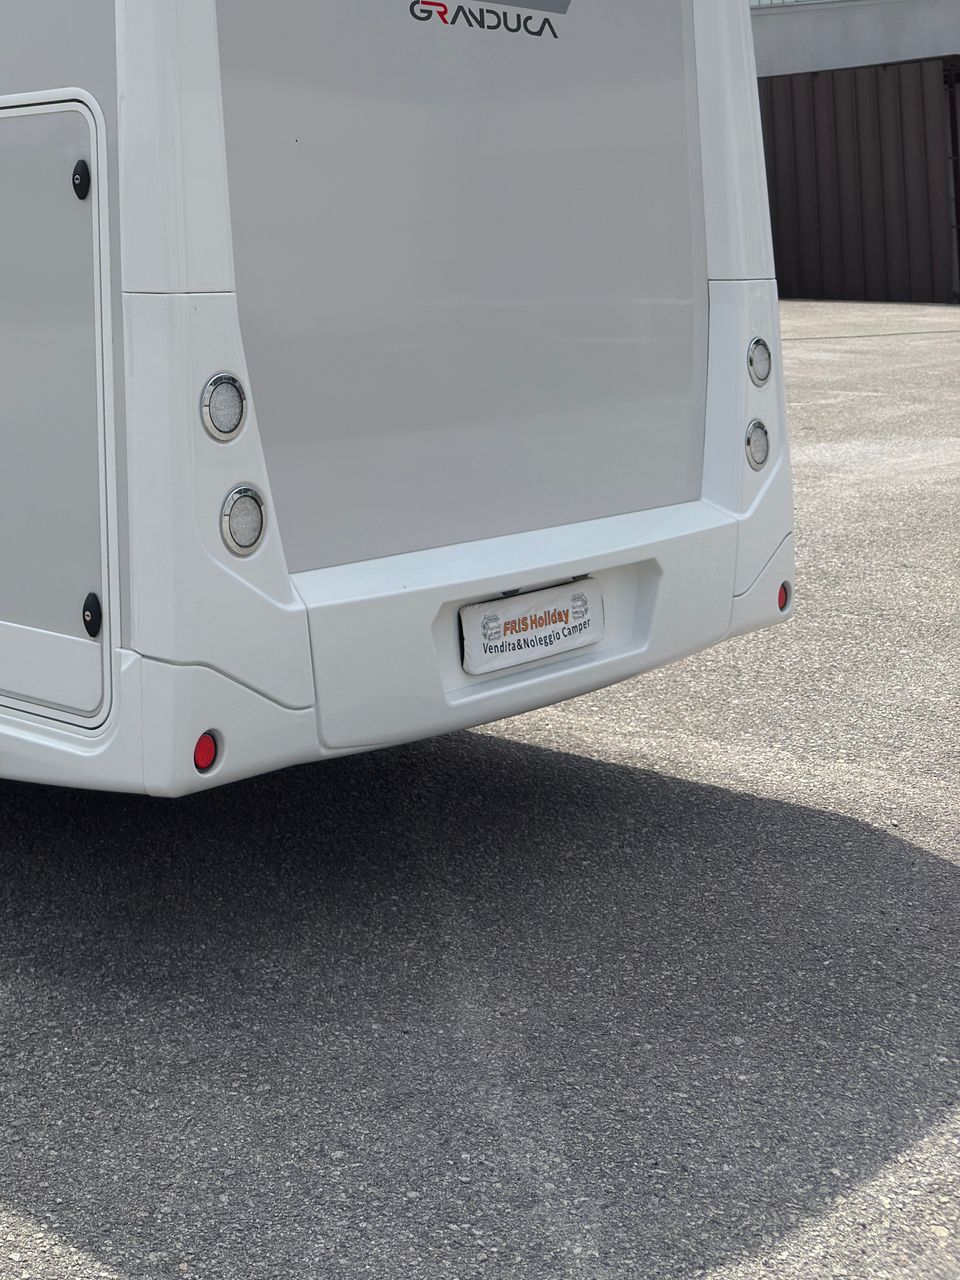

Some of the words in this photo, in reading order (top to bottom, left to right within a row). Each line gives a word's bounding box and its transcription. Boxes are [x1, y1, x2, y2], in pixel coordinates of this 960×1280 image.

[409, 0, 558, 39] GRANDUCA
[483, 630, 561, 654] Vendita&Noleggio
[562, 618, 591, 638] Camper
[503, 616, 529, 637] FRIS
[529, 608, 570, 630] Holiday
